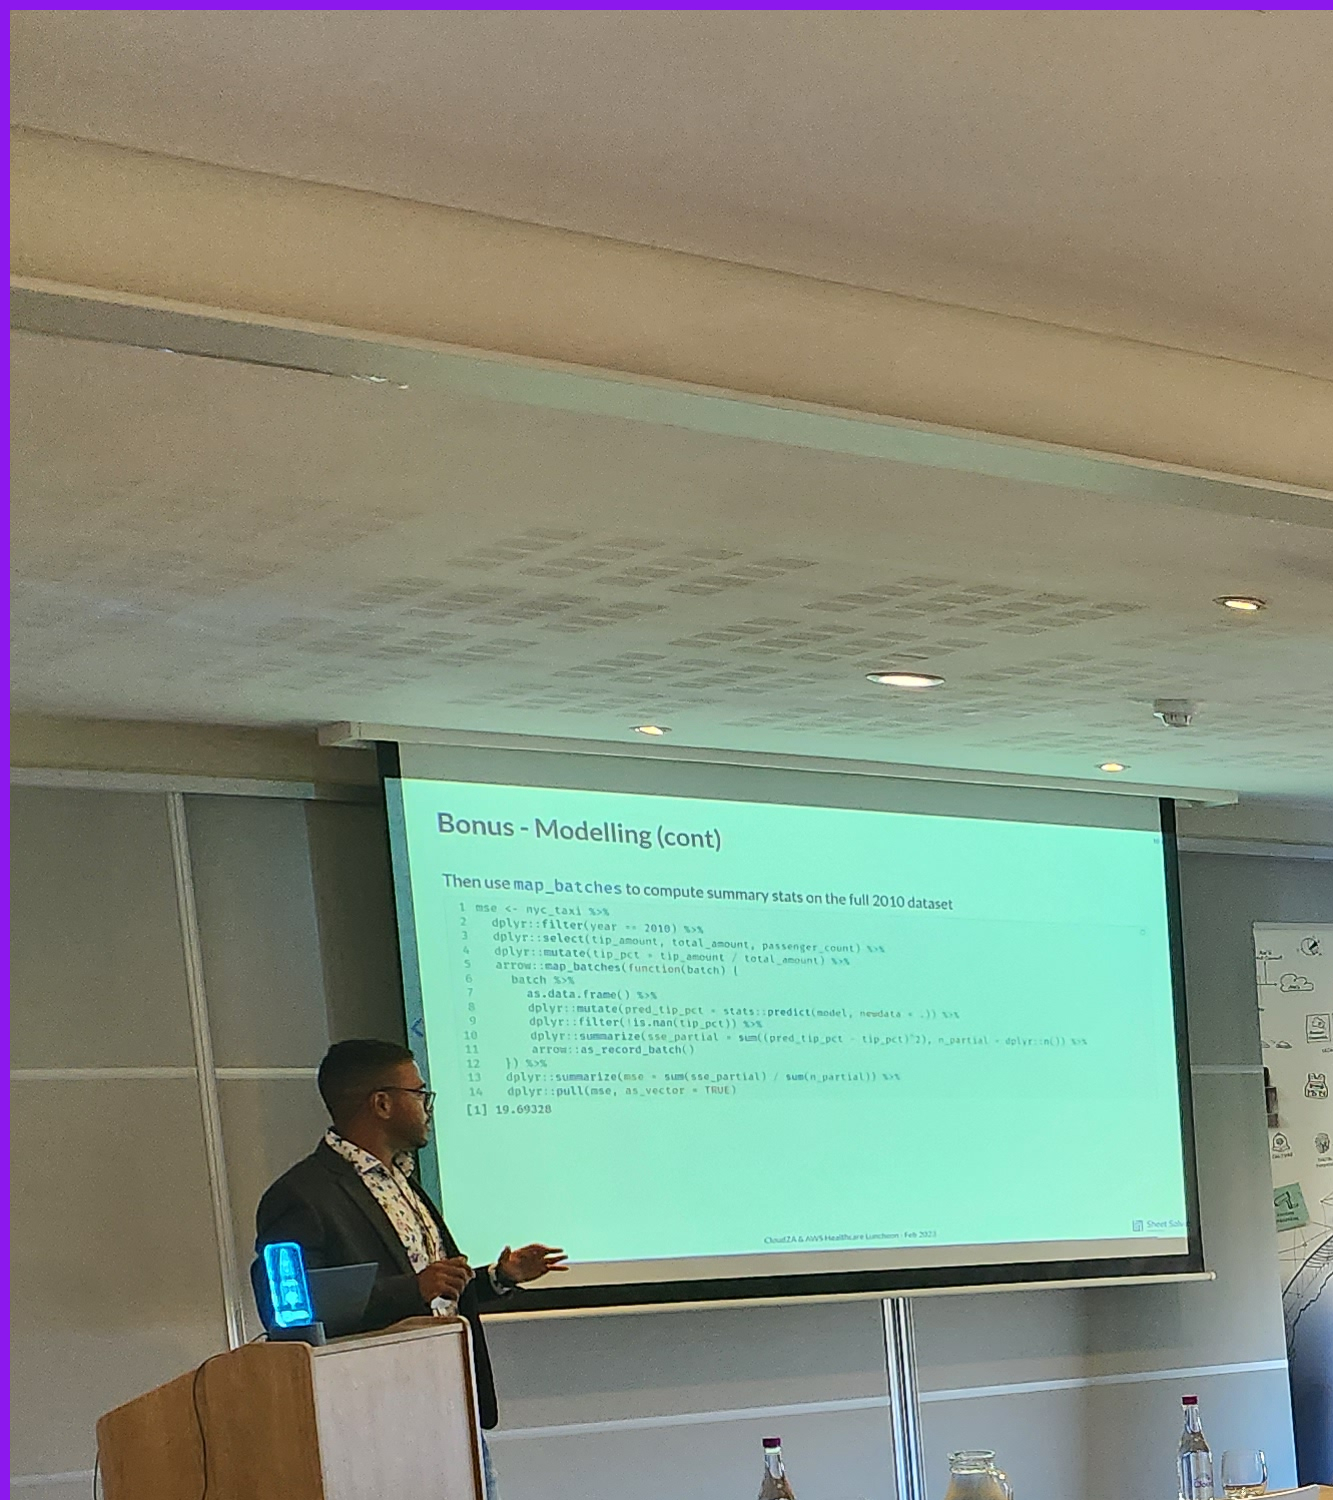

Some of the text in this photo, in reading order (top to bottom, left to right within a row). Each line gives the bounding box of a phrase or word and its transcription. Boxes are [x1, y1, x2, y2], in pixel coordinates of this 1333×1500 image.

[437, 812, 515, 837] Bonus
[534, 818, 652, 849] Modelling
[657, 824, 722, 852] (cont)
[442, 873, 953, 910] Then use map_batches to compute summary stats on the full 2010 dataset
[511, 975, 546, 985] batch
[496, 1104, 552, 1115] 19.69328
